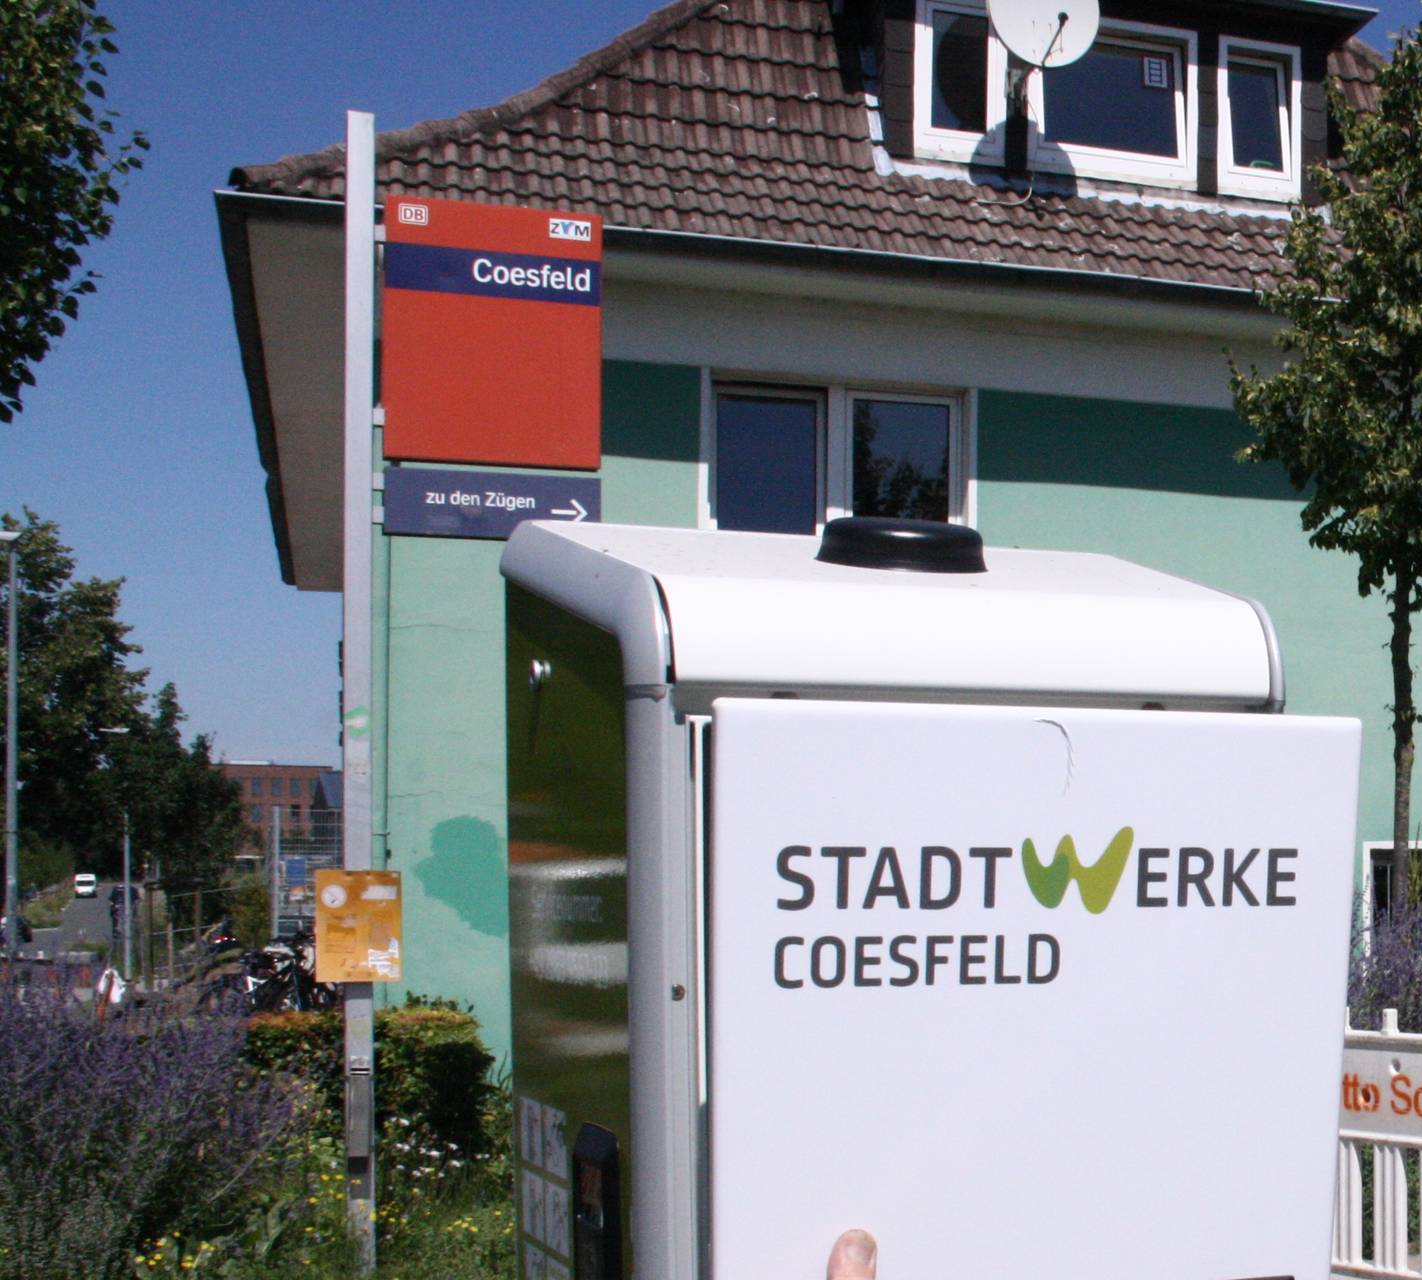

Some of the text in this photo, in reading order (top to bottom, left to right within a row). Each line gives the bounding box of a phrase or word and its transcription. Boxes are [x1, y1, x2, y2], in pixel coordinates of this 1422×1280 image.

[402, 207, 424, 222] DB
[473, 258, 591, 292] Coesfeld
[425, 490, 536, 512] zu den Zügen
[775, 825, 1299, 915] STADTWERKE
[773, 933, 1061, 989] COESFELD
